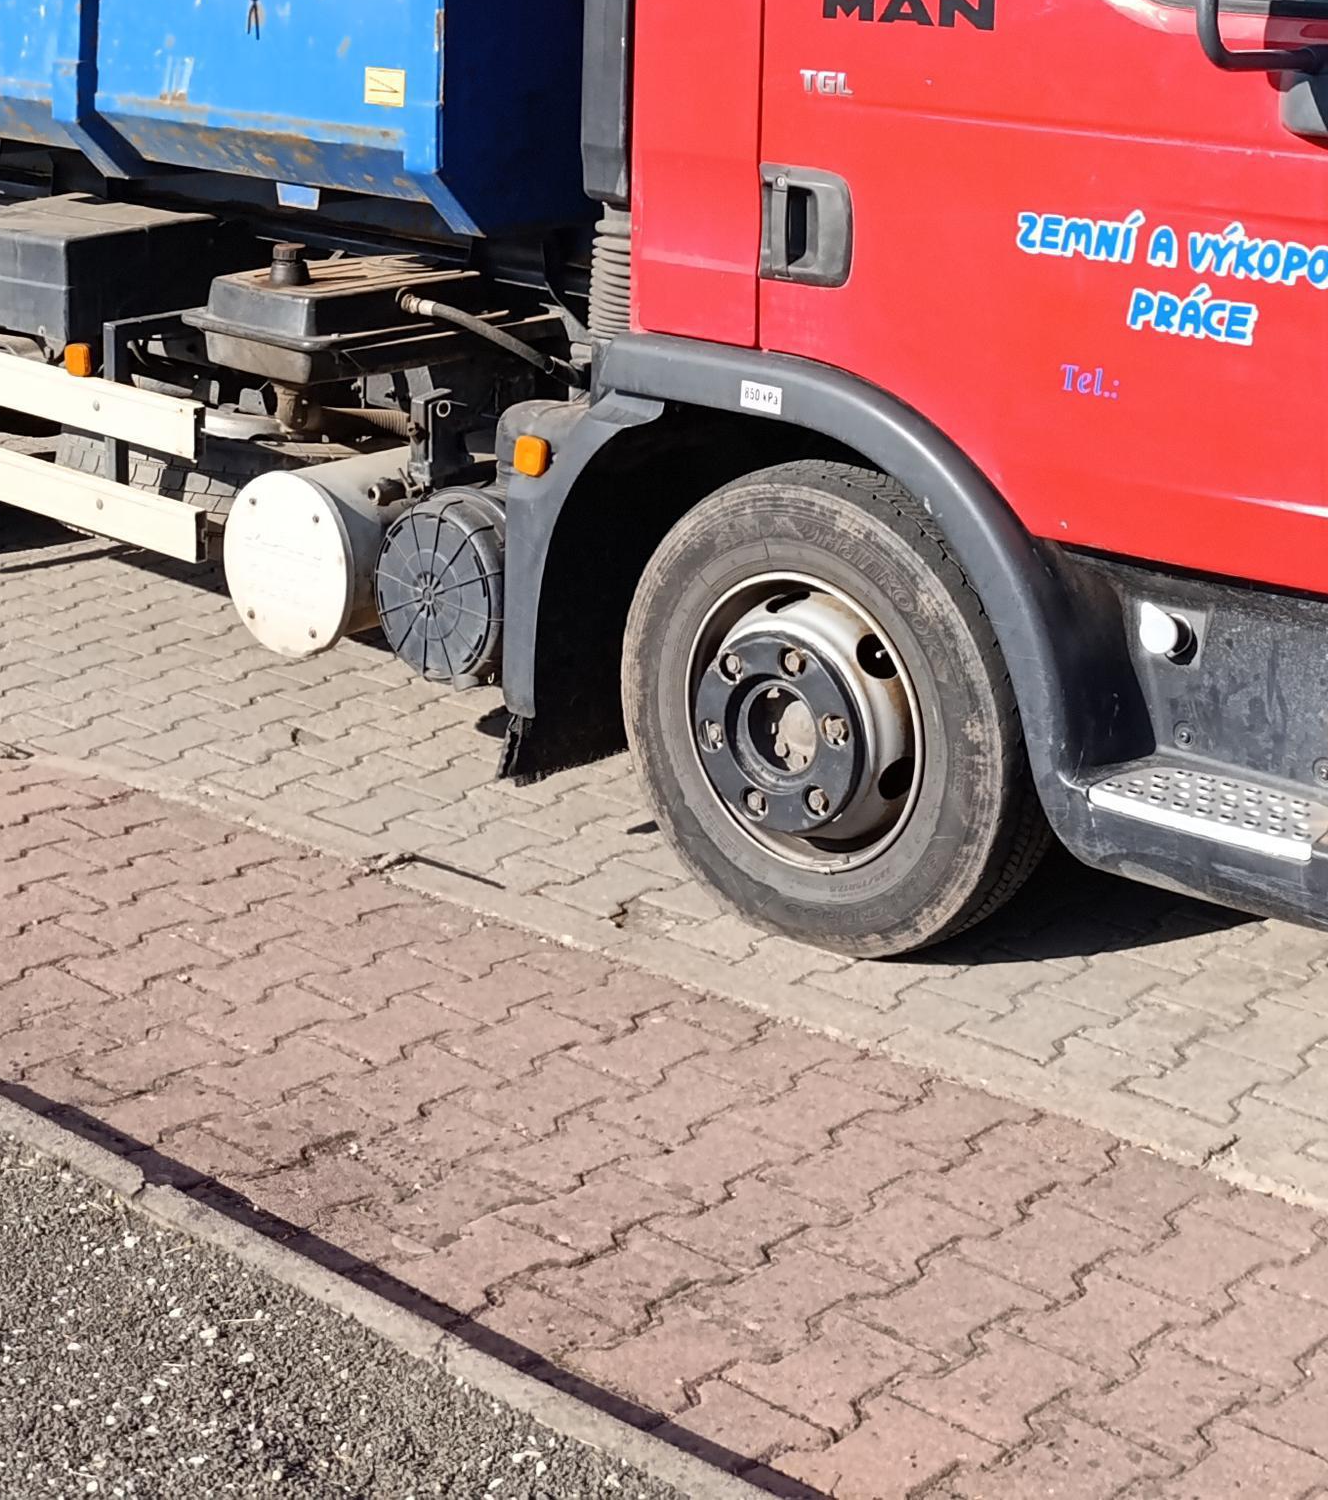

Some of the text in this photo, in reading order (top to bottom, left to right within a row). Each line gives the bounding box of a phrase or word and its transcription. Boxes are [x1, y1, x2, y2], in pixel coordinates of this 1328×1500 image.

[800, 69, 855, 96] TGL
[1017, 211, 1144, 263] ZEMNÍ
[1148, 226, 1177, 268] A
[1127, 283, 1258, 346] PRÁCE
[744, 387, 760, 401] 850
[1060, 364, 1119, 399] Tel.:
